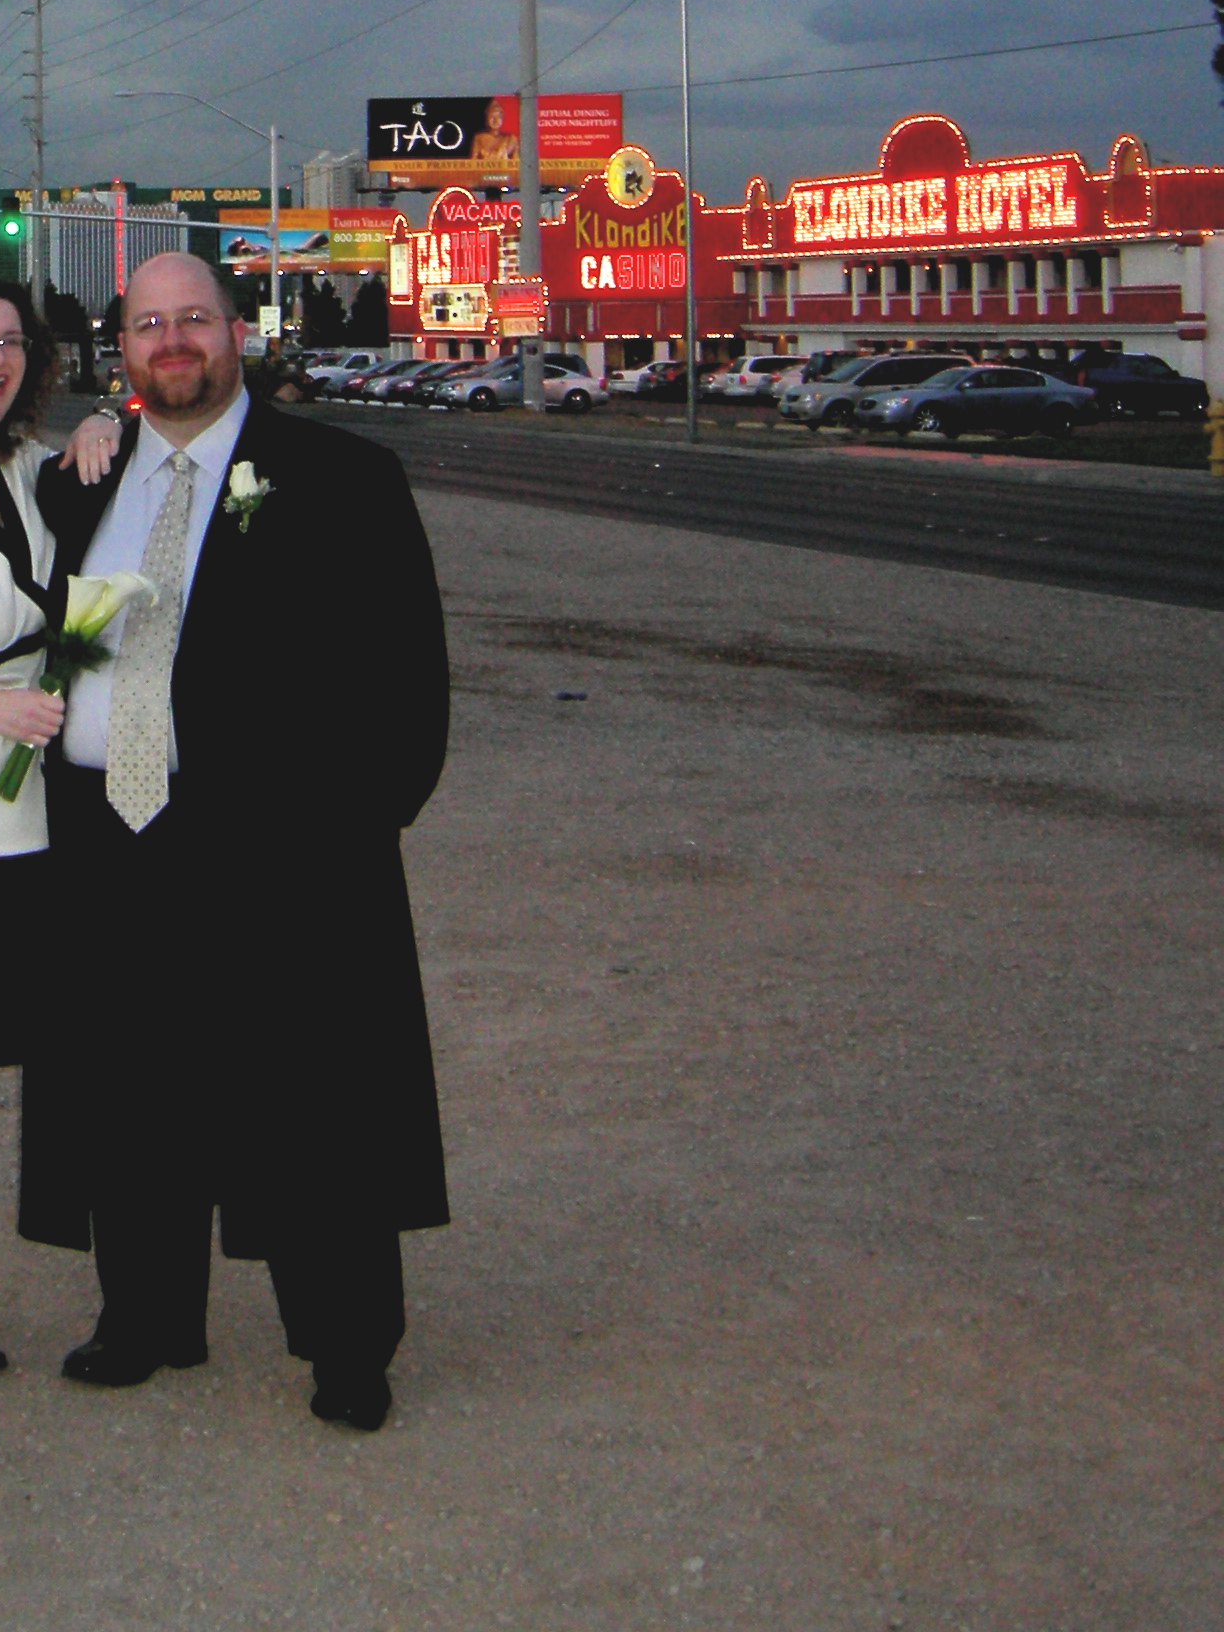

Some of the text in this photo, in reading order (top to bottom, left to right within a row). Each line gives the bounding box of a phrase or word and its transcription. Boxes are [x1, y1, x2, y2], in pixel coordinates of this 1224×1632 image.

[379, 120, 463, 152] TAO
[170, 189, 262, 202] MGM GRAND
[793, 164, 1077, 244] KLONDIKE HOTEL
[362, 217, 391, 228] VILLAG
[442, 204, 522, 221] VACANC
[417, 230, 490, 284] CASINO
[580, 252, 686, 290] CASINO
